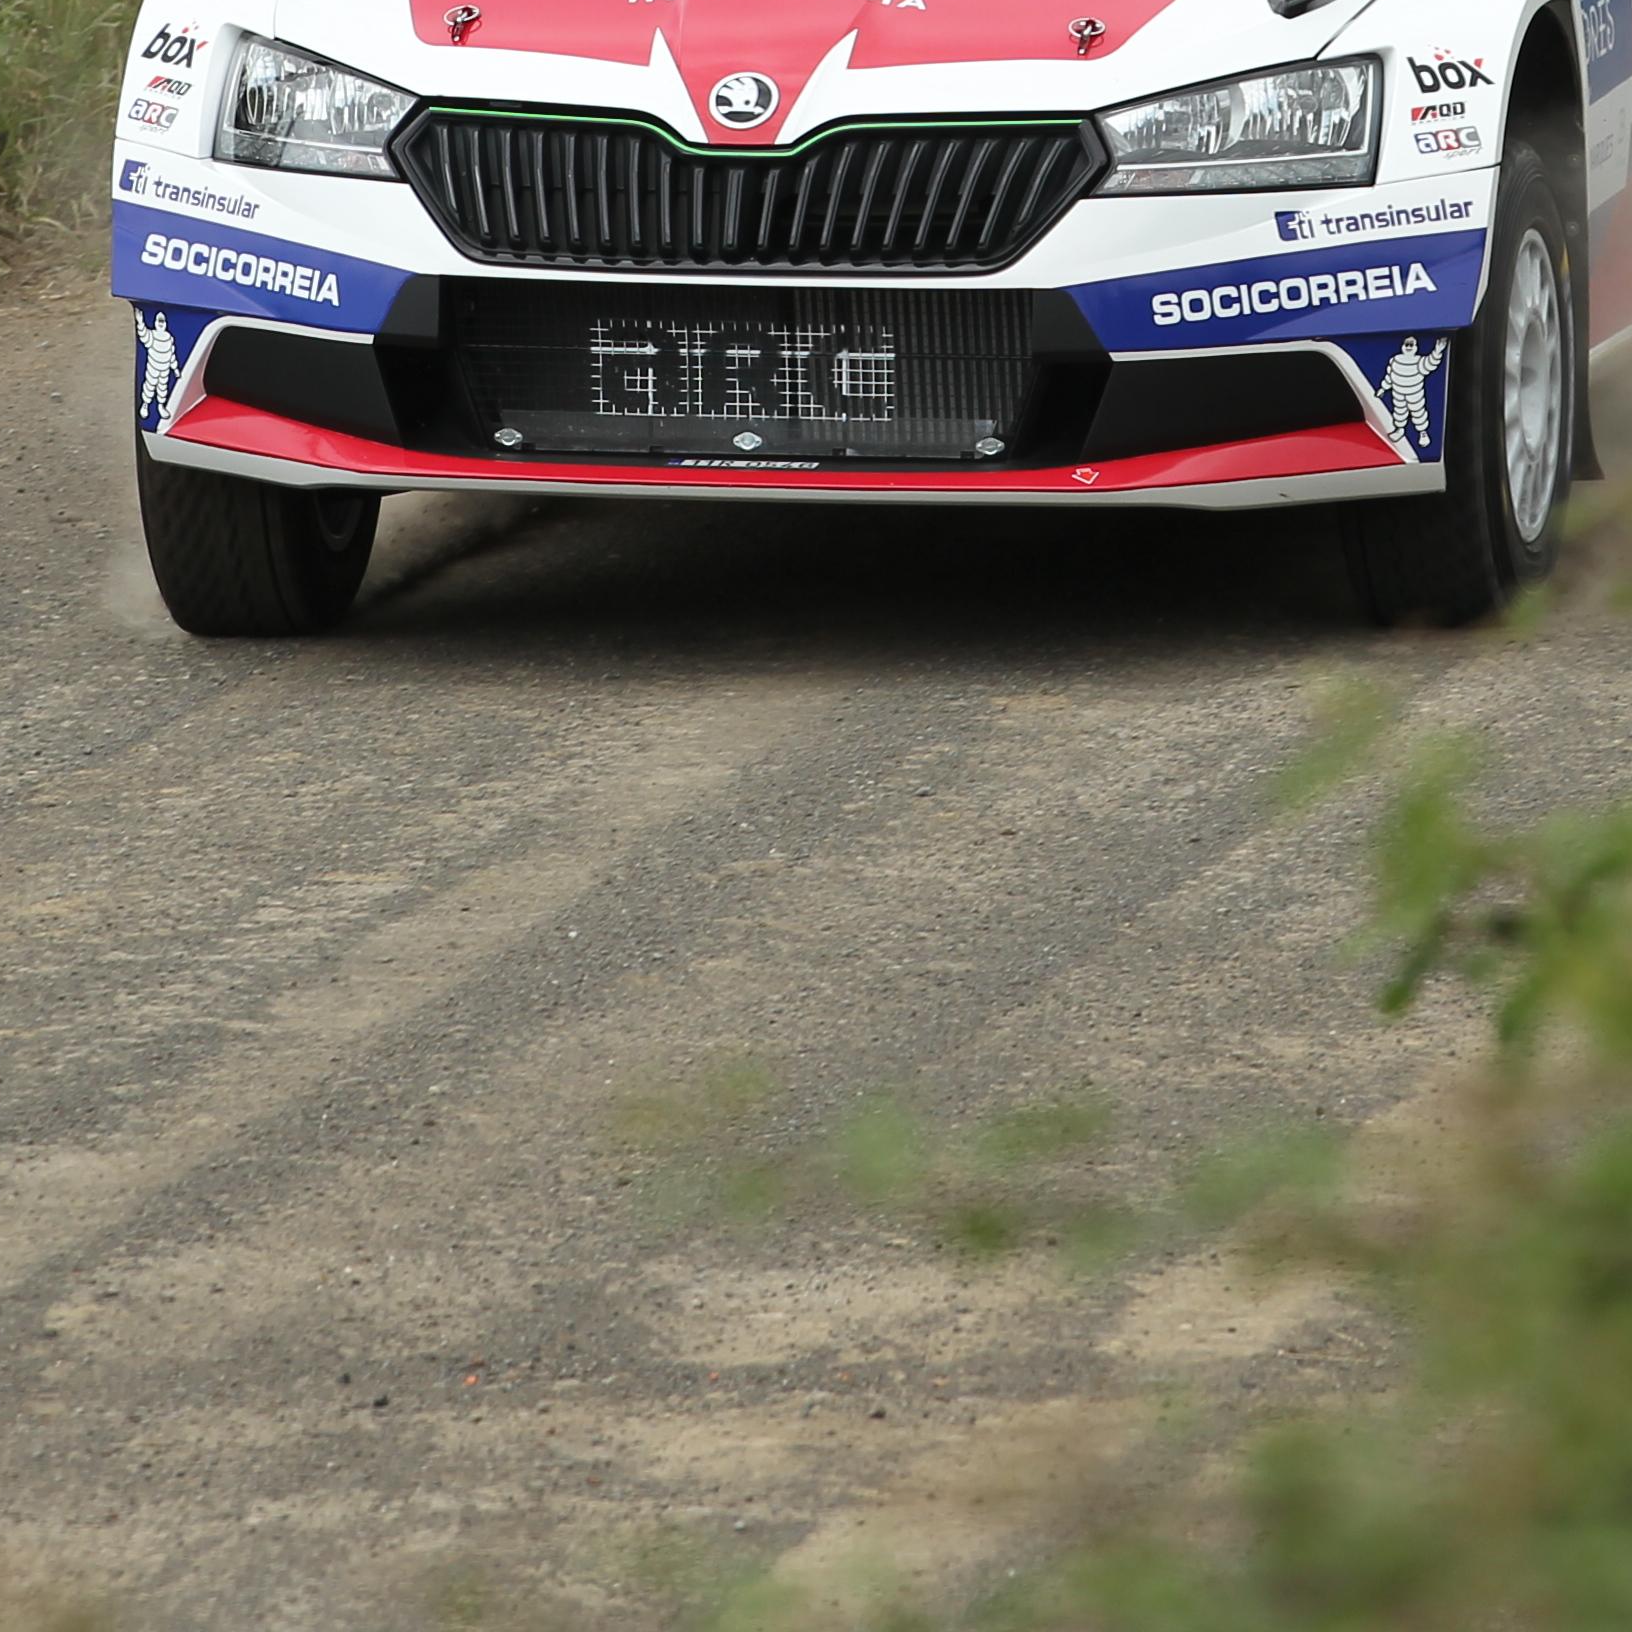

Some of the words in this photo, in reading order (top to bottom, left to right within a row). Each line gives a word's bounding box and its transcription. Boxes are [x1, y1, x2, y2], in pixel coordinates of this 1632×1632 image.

[141, 23, 208, 68] box
[1406, 56, 1495, 94] box
[152, 175, 261, 220] transinsular
[1320, 198, 1473, 237] transinsular
[141, 233, 340, 307] SOCICORREIA
[1152, 262, 1438, 326] SOCICORREIA
